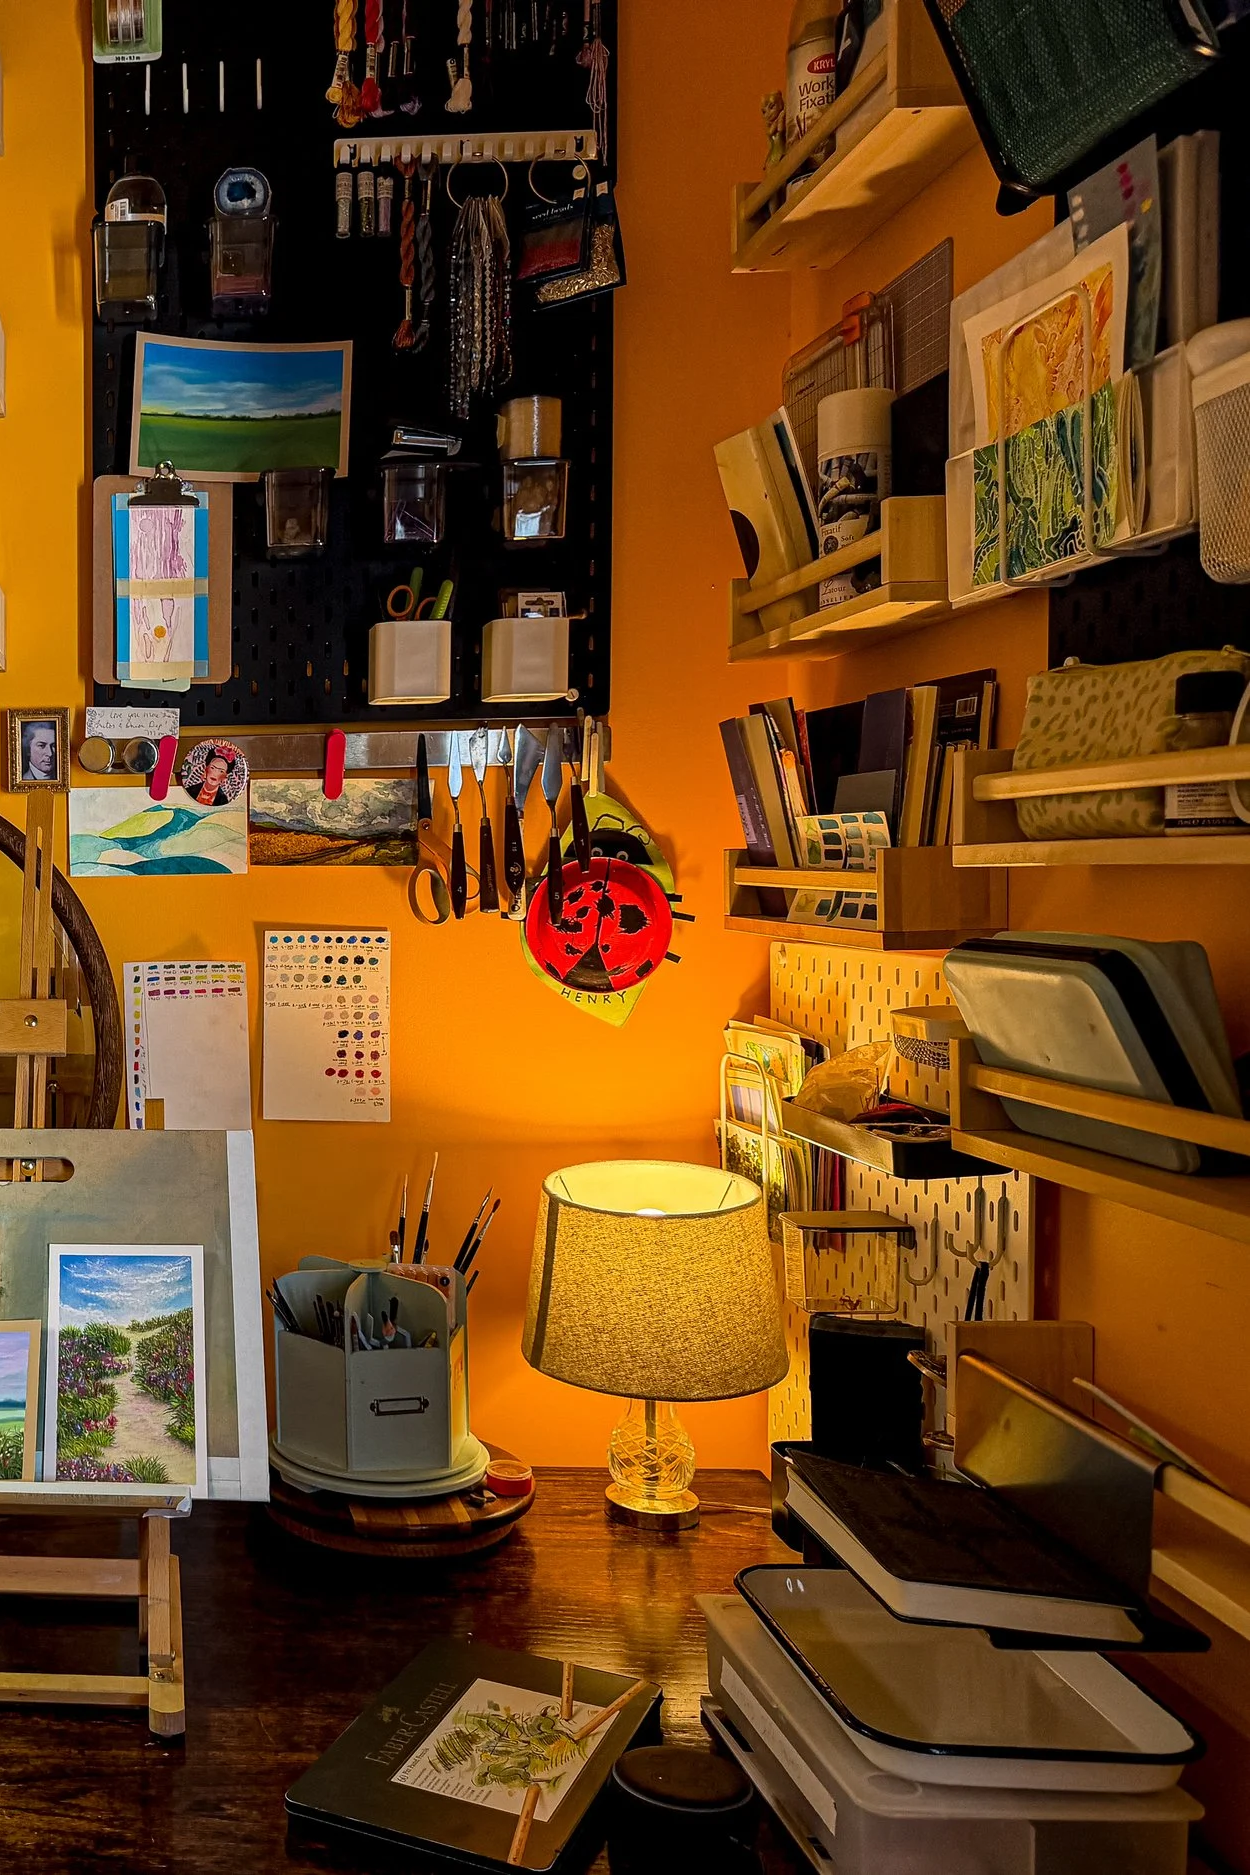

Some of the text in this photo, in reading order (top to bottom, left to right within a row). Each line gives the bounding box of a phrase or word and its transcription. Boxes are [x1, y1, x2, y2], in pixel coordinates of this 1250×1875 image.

[813, 60, 836, 70] KRYL
[799, 76, 834, 96] Work
[800, 92, 835, 112] Fixati
[561, 988, 626, 1004] HENRY
[364, 1682, 458, 1766] FABER-CASTELL
